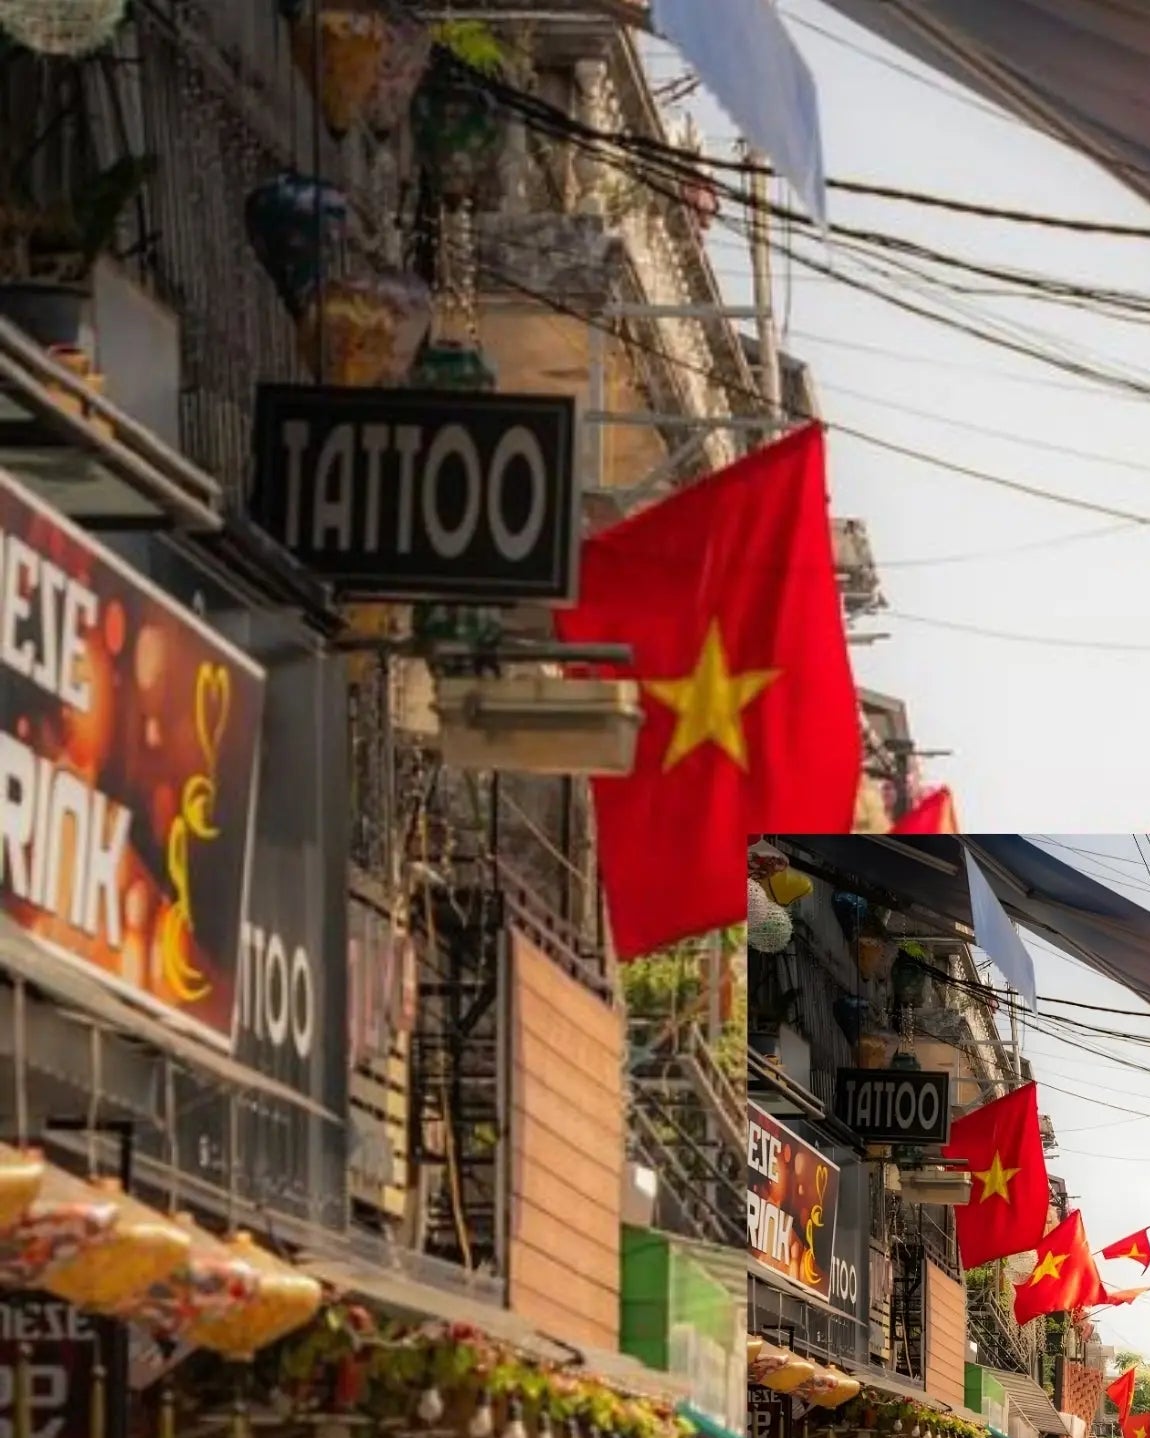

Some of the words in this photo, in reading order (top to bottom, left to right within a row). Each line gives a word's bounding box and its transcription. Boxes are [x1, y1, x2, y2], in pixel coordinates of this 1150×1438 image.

[281, 423, 546, 562] TATTOO
[0, 535, 98, 713] ESE
[845, 1081, 939, 1130] TATTOO
